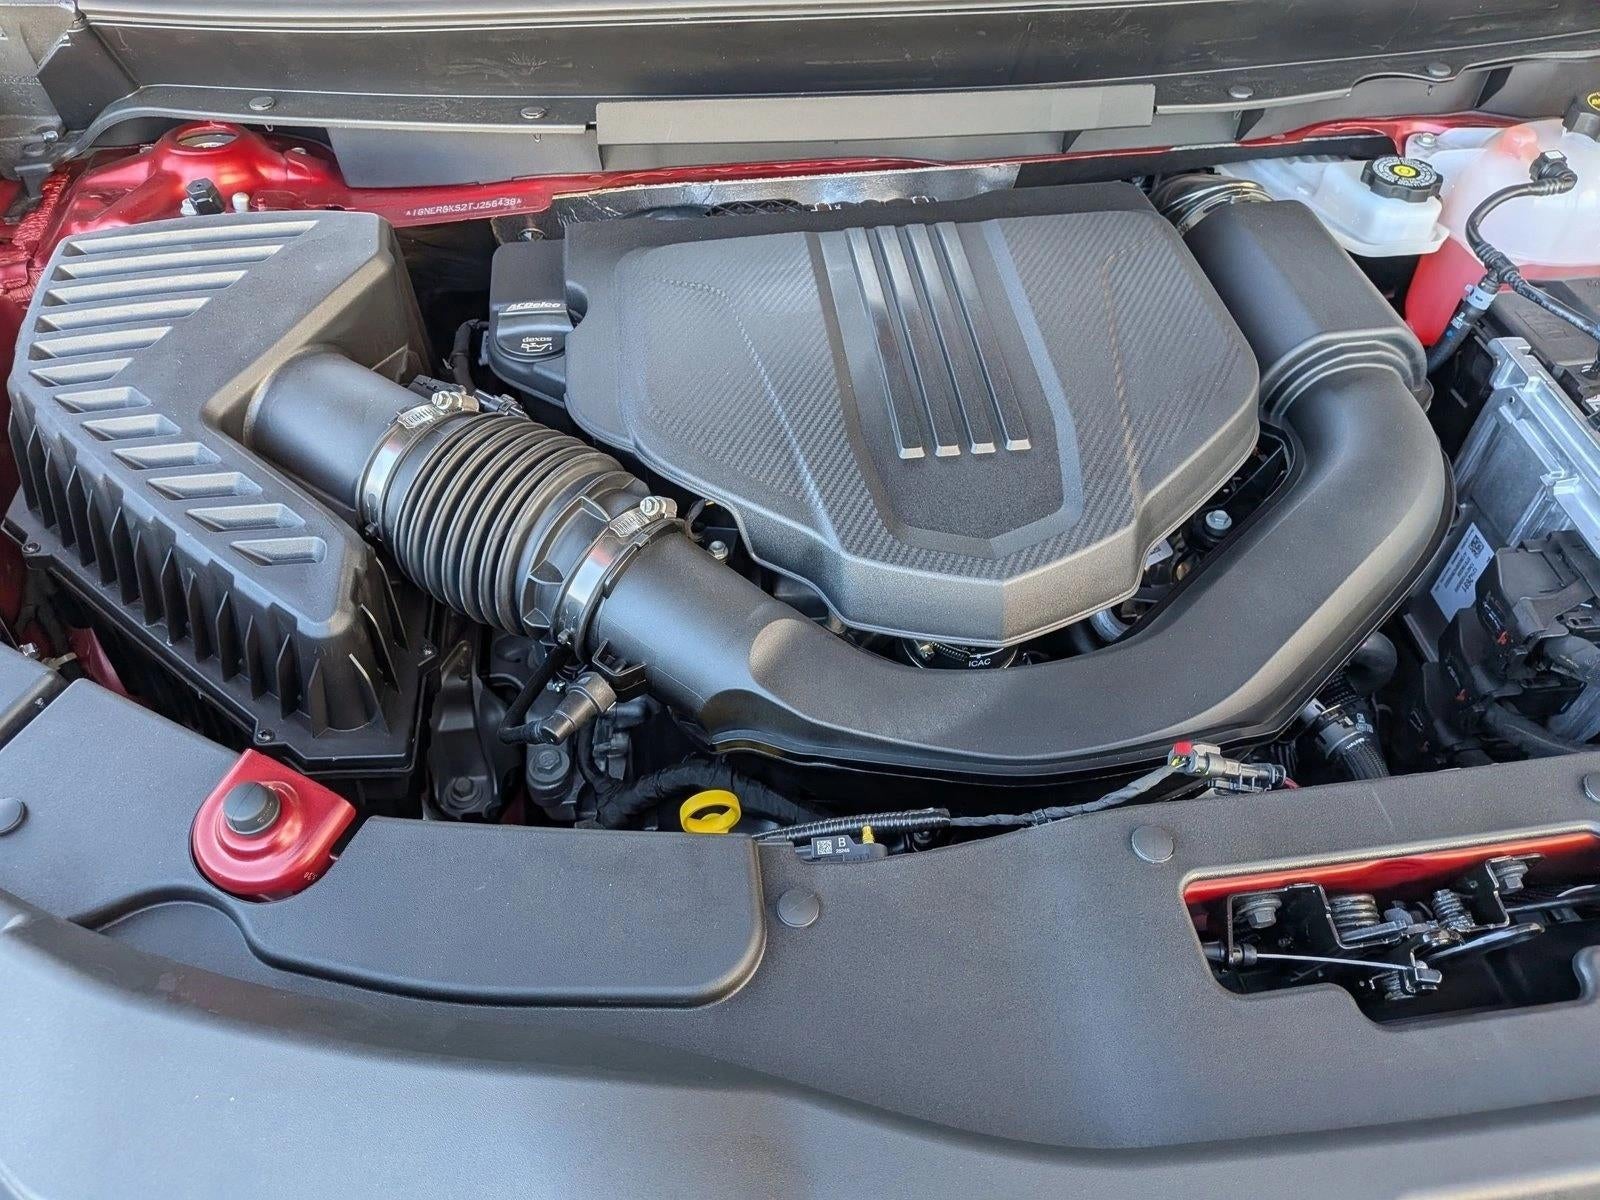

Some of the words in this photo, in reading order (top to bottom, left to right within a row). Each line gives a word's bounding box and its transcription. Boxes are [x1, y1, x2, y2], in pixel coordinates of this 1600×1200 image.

[506, 302, 561, 311] ACDelco
[968, 658, 991, 668] ICAC
[838, 837, 846, 848] B
